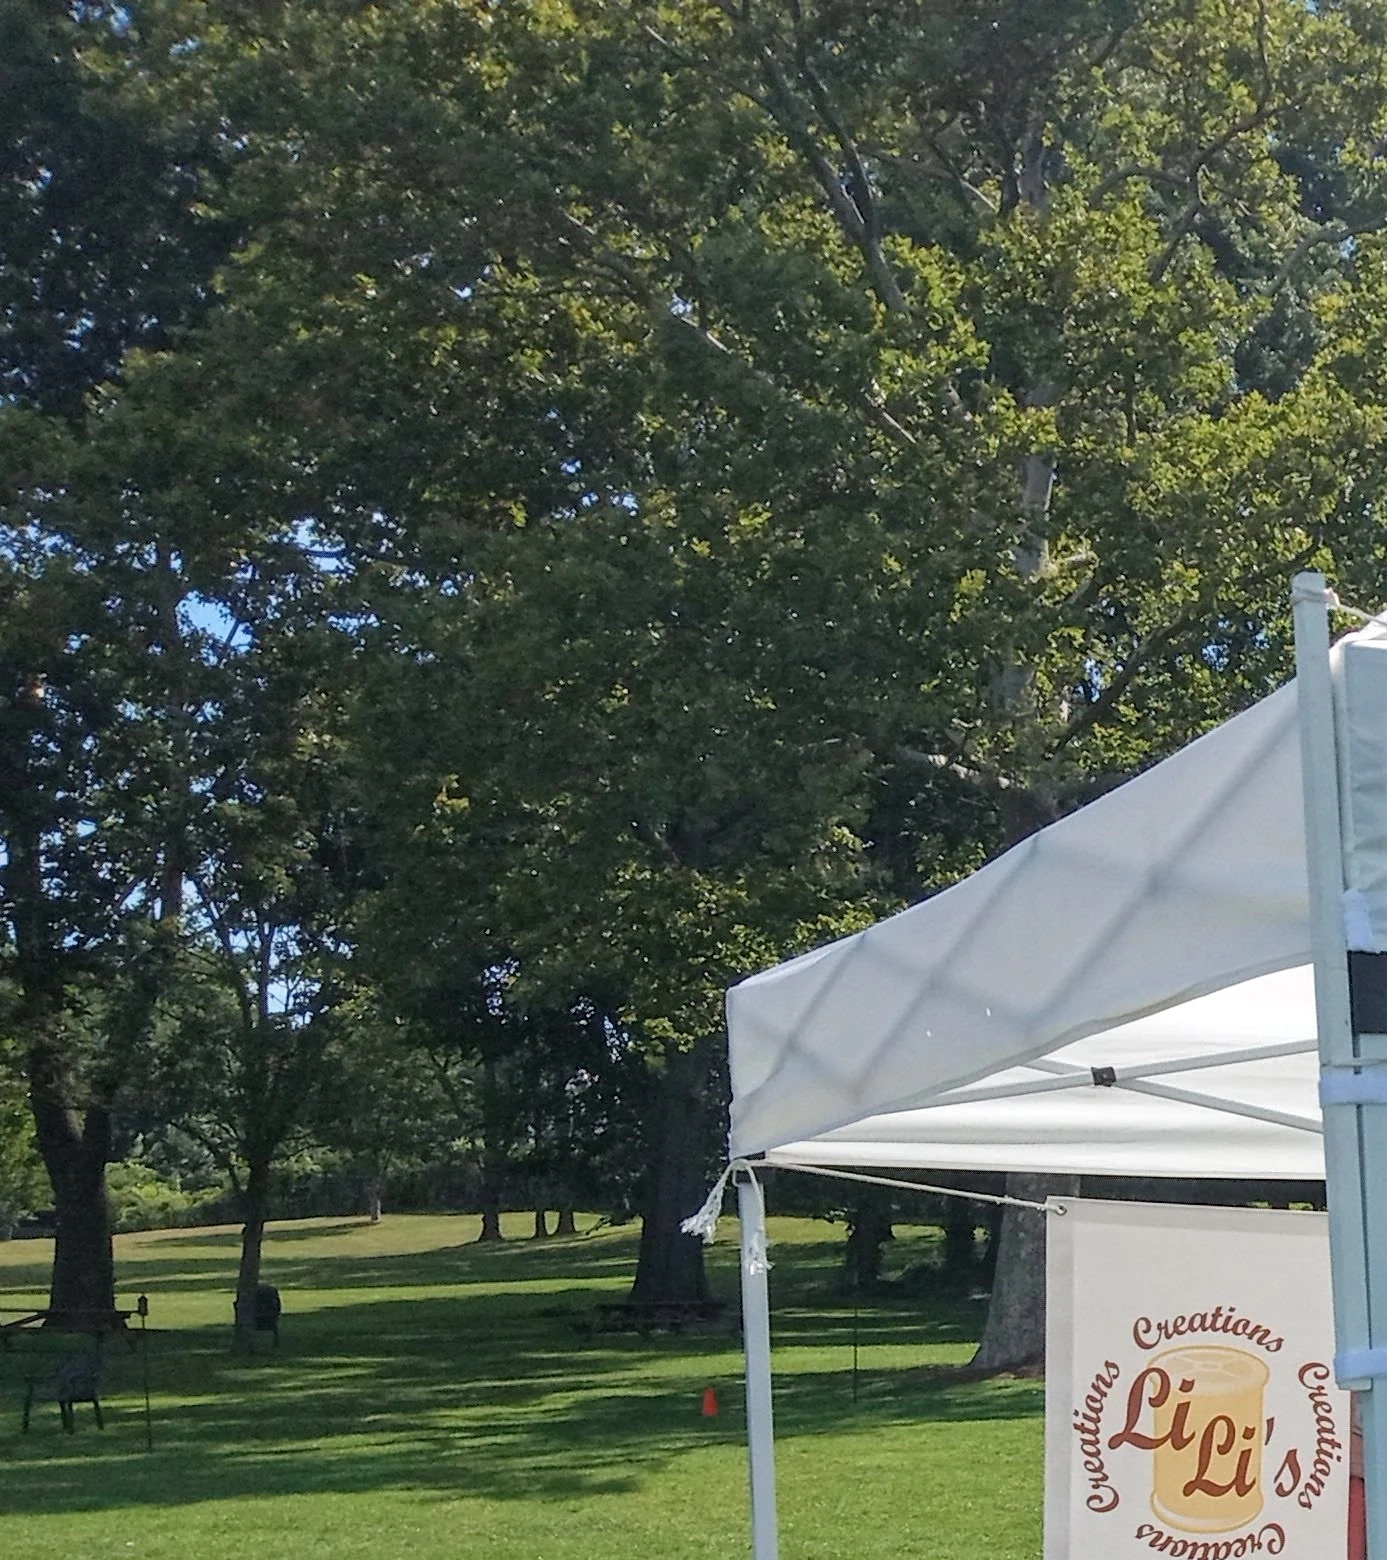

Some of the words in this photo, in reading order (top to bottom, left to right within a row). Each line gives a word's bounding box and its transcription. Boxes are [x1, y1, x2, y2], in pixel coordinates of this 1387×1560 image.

[1132, 1306, 1285, 1353] Creations
[1073, 1359, 1121, 1514] Creations
[1108, 1367, 1196, 1451] Li
[1298, 1361, 1344, 1510] Creations
[1182, 1414, 1301, 1497] Li's
